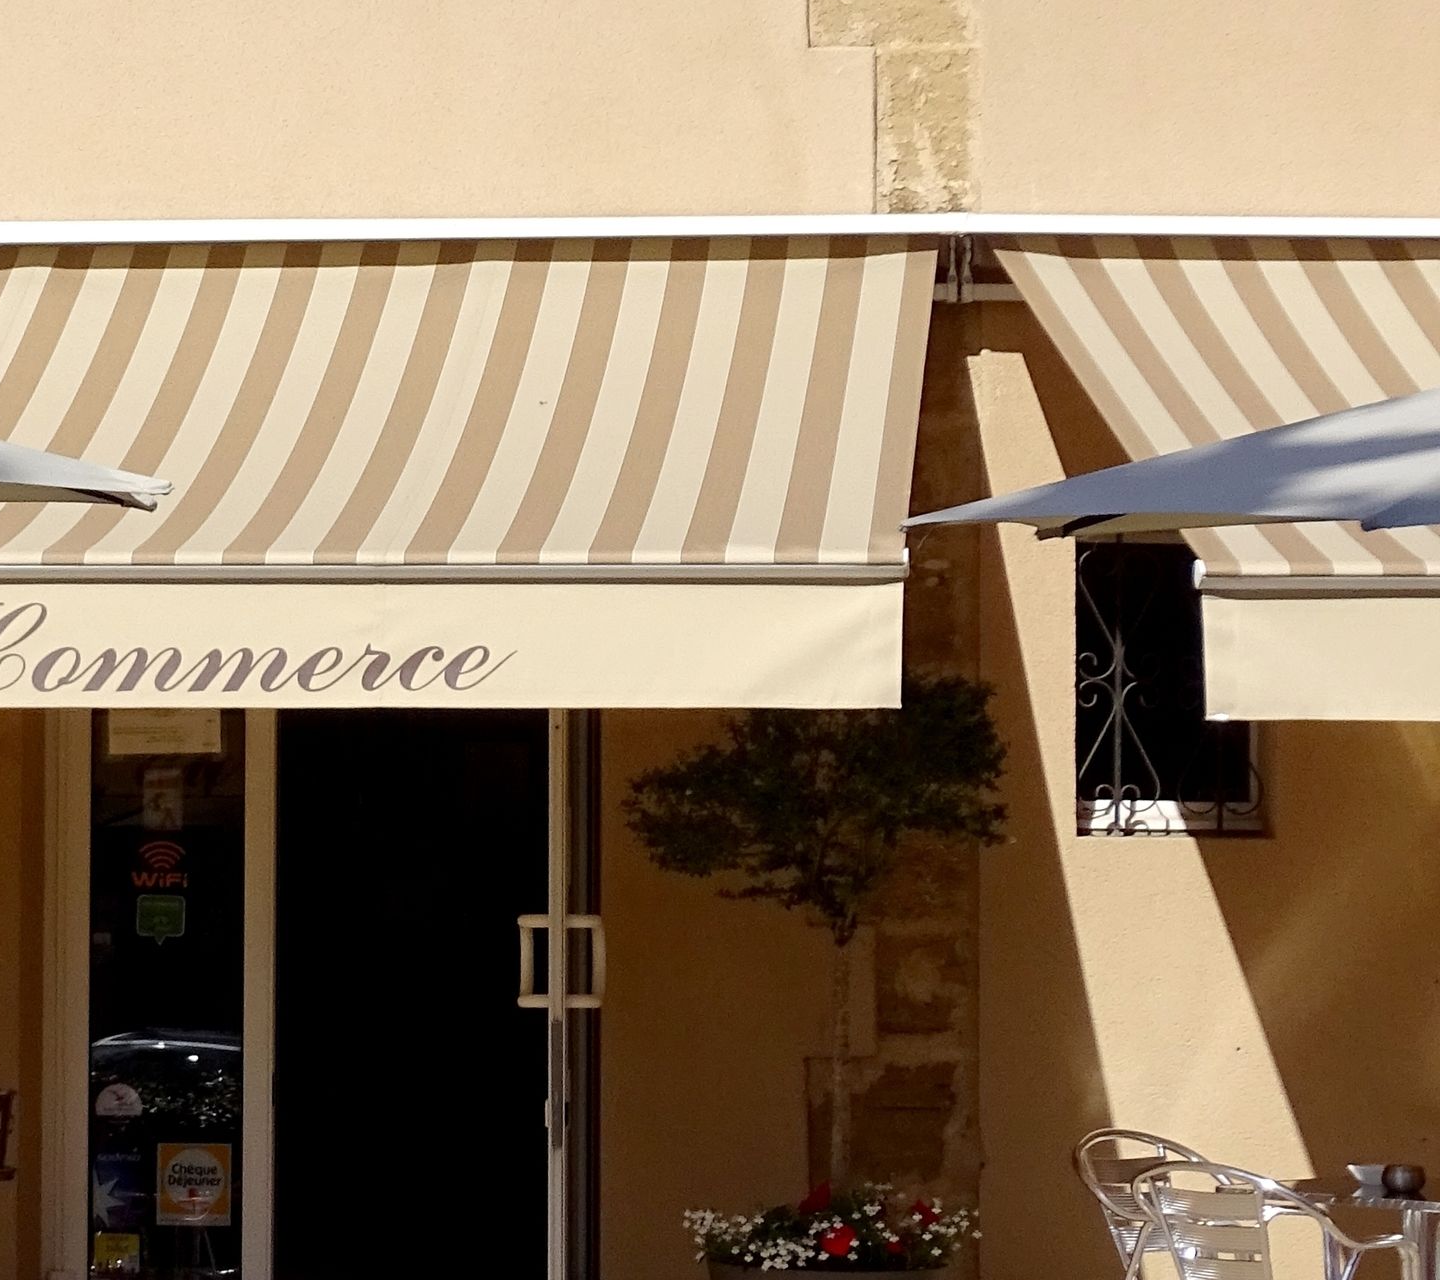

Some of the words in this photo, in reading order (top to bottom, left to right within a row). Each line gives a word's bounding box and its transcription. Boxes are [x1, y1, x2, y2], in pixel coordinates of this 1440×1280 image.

[130, 871, 188, 889] WiFi
[172, 1162, 218, 1177] Chèque
[168, 1175, 223, 1188] Déjeuner
